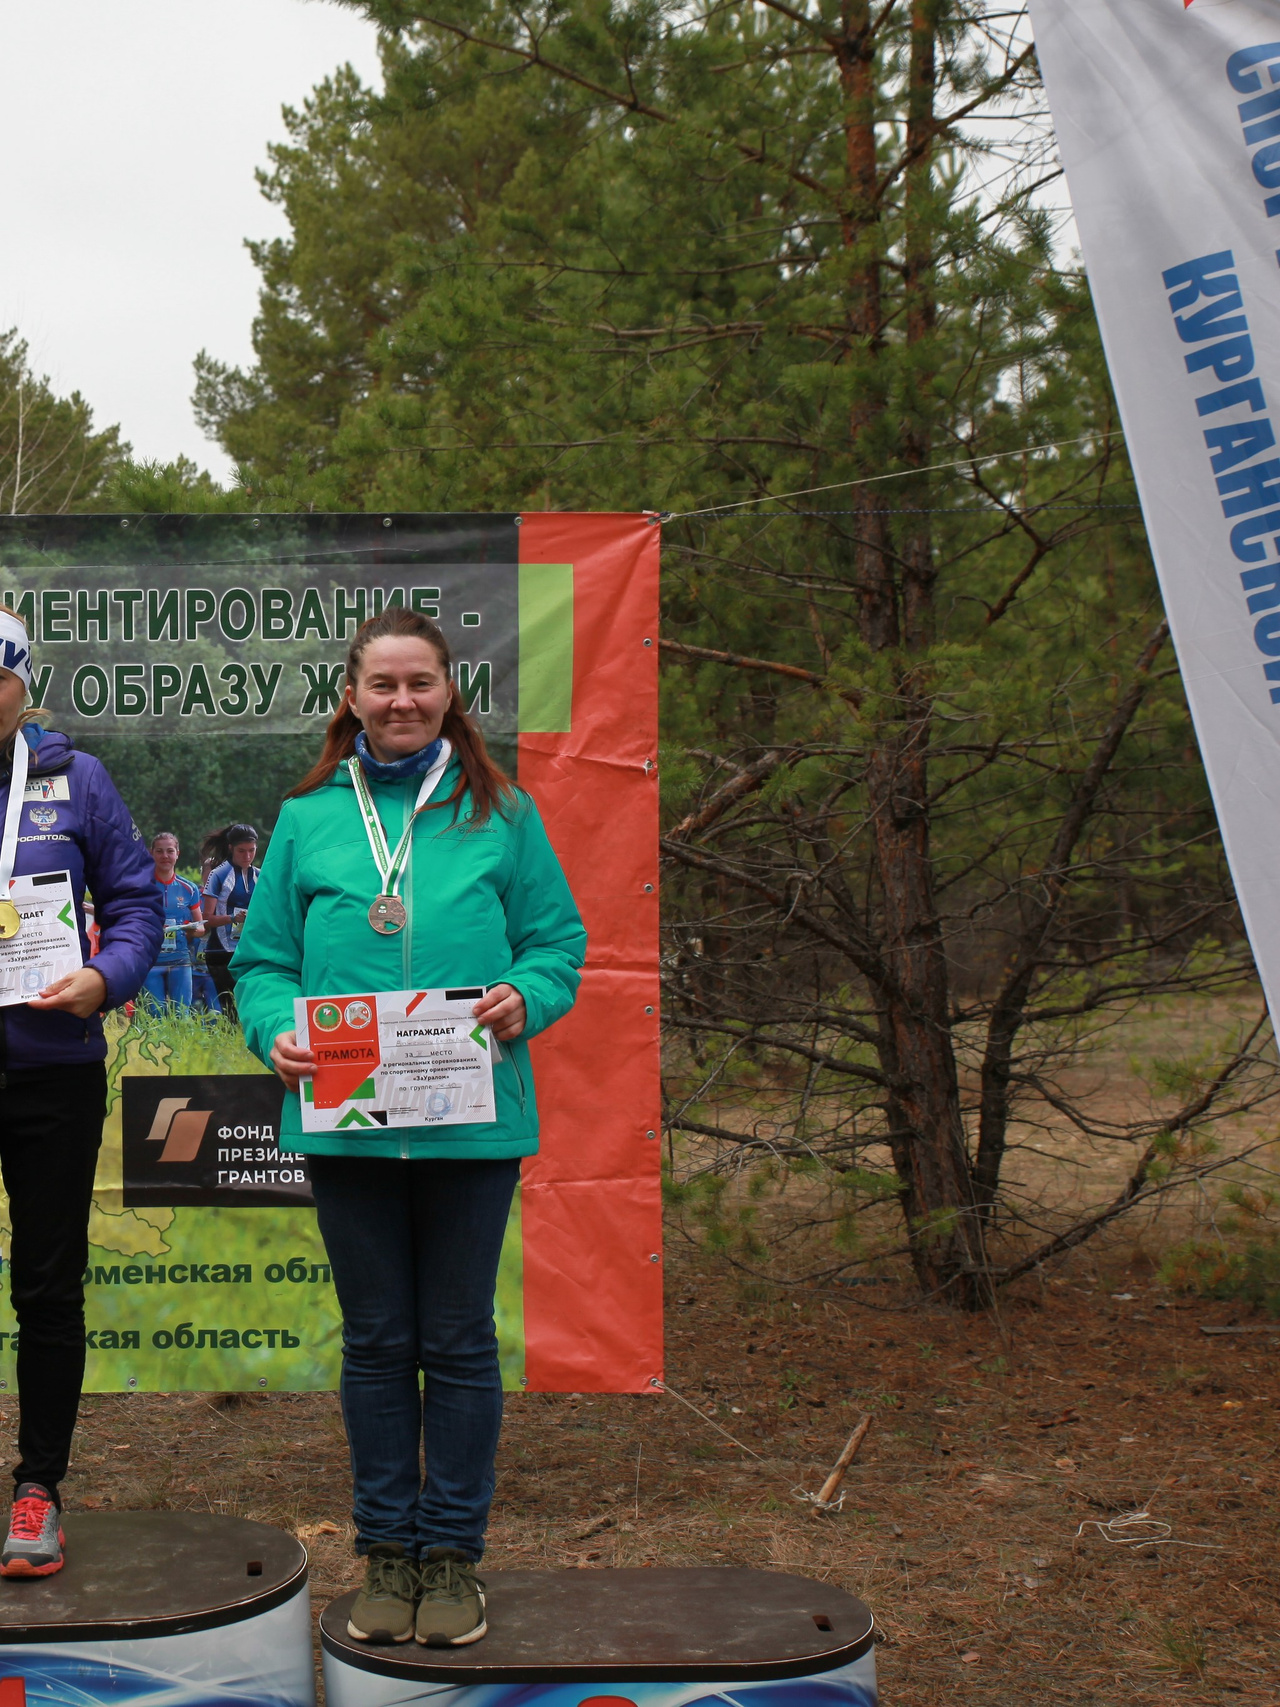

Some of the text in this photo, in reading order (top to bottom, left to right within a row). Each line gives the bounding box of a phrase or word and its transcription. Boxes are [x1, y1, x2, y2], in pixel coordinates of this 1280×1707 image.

[72, 662, 282, 718] ОБРАЗУ
[396, 1027, 456, 1038] НАГРАЖДАЕТ
[317, 1048, 375, 1061] ГРАМОТА
[388, 1060, 430, 1069] региональных
[431, 1057, 477, 1066] соревнованиях
[389, 1068, 428, 1077] спортивному
[429, 1065, 481, 1074] ориентированию
[409, 1084, 432, 1092] группе
[217, 1125, 275, 1141] ФОНД
[217, 1148, 306, 1163] ПРЕЗИДЕ
[218, 1169, 306, 1184] ГРАНТОВ
[81, 1264, 252, 1285] менская
[152, 1321, 301, 1349] область
